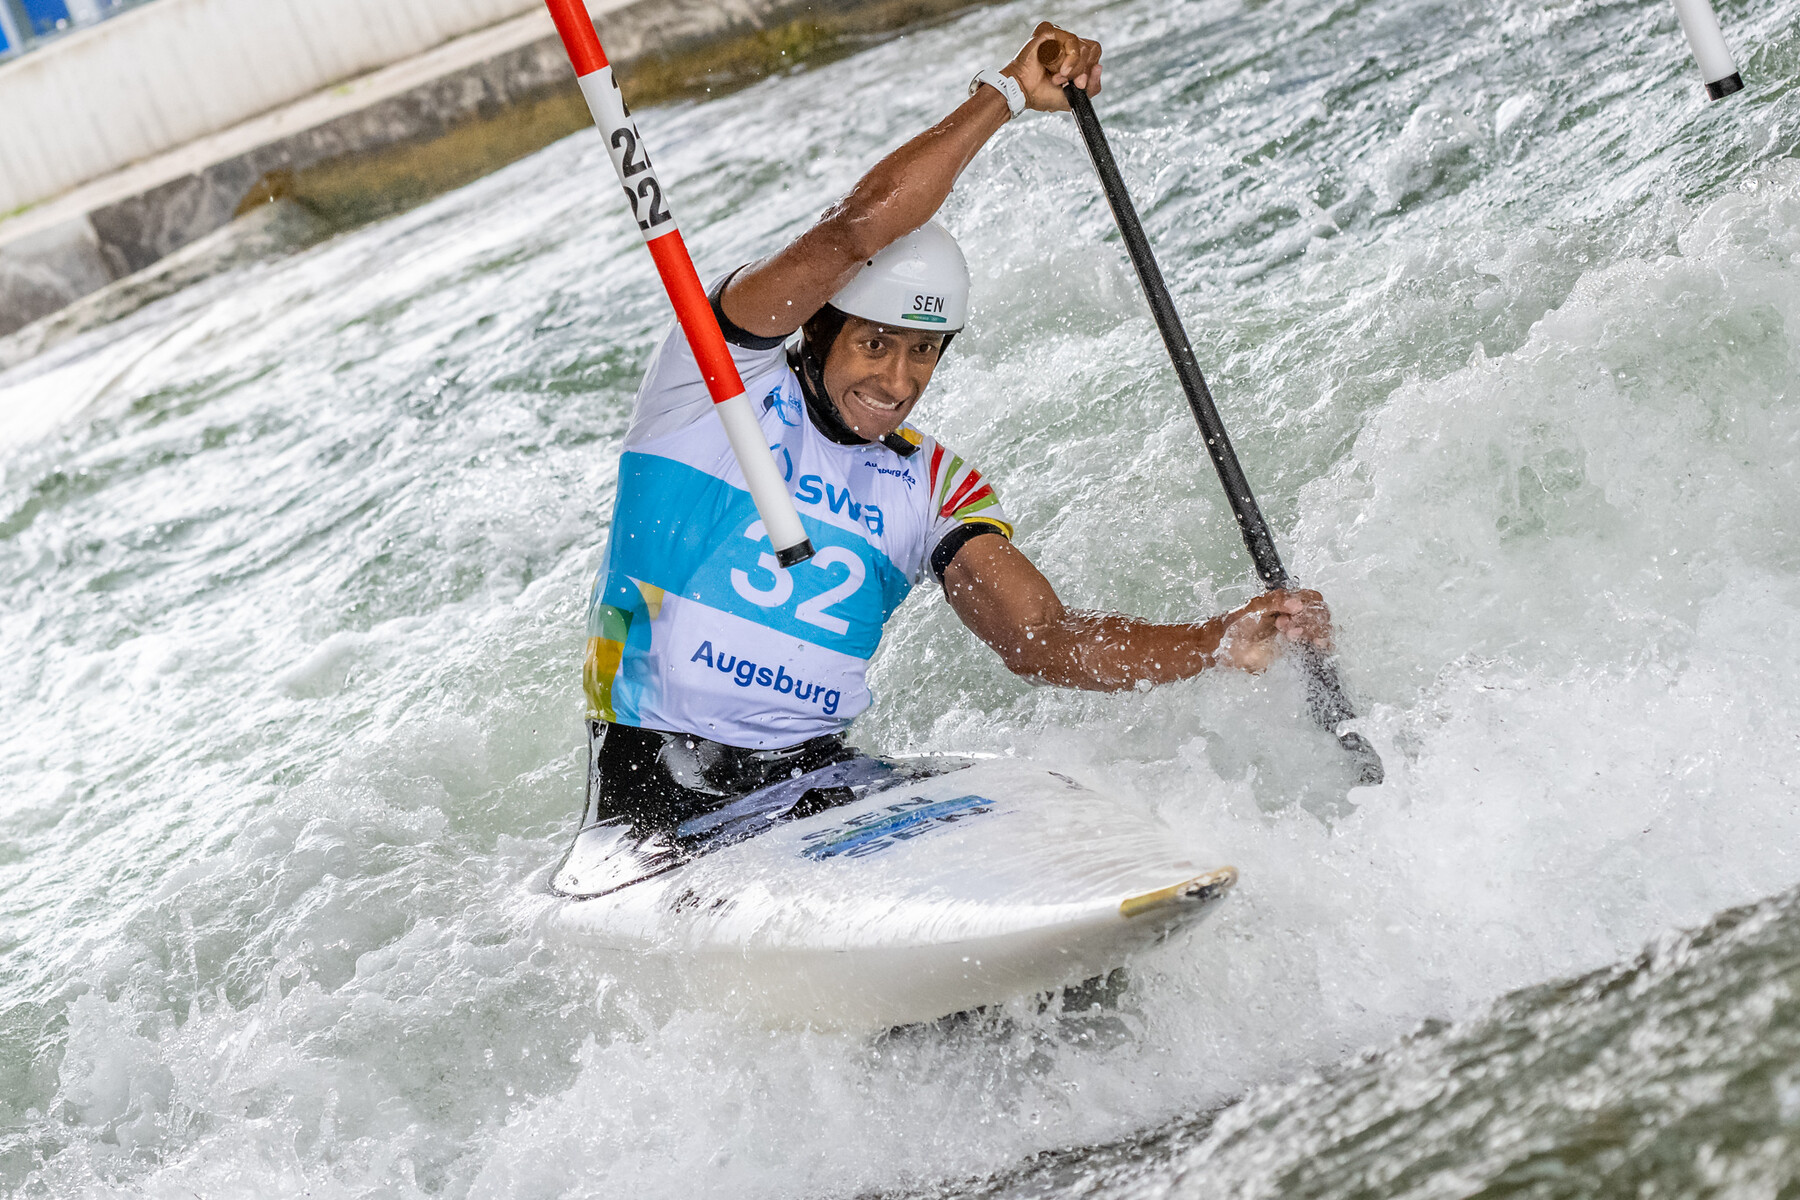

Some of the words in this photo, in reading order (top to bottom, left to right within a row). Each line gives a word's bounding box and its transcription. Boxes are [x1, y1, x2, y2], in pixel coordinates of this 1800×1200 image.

[912, 295, 945, 313] SEN
[864, 461, 901, 477] Auburg
[795, 474, 884, 537] swa
[730, 518, 866, 636] 32
[690, 640, 841, 715] Augsburg
